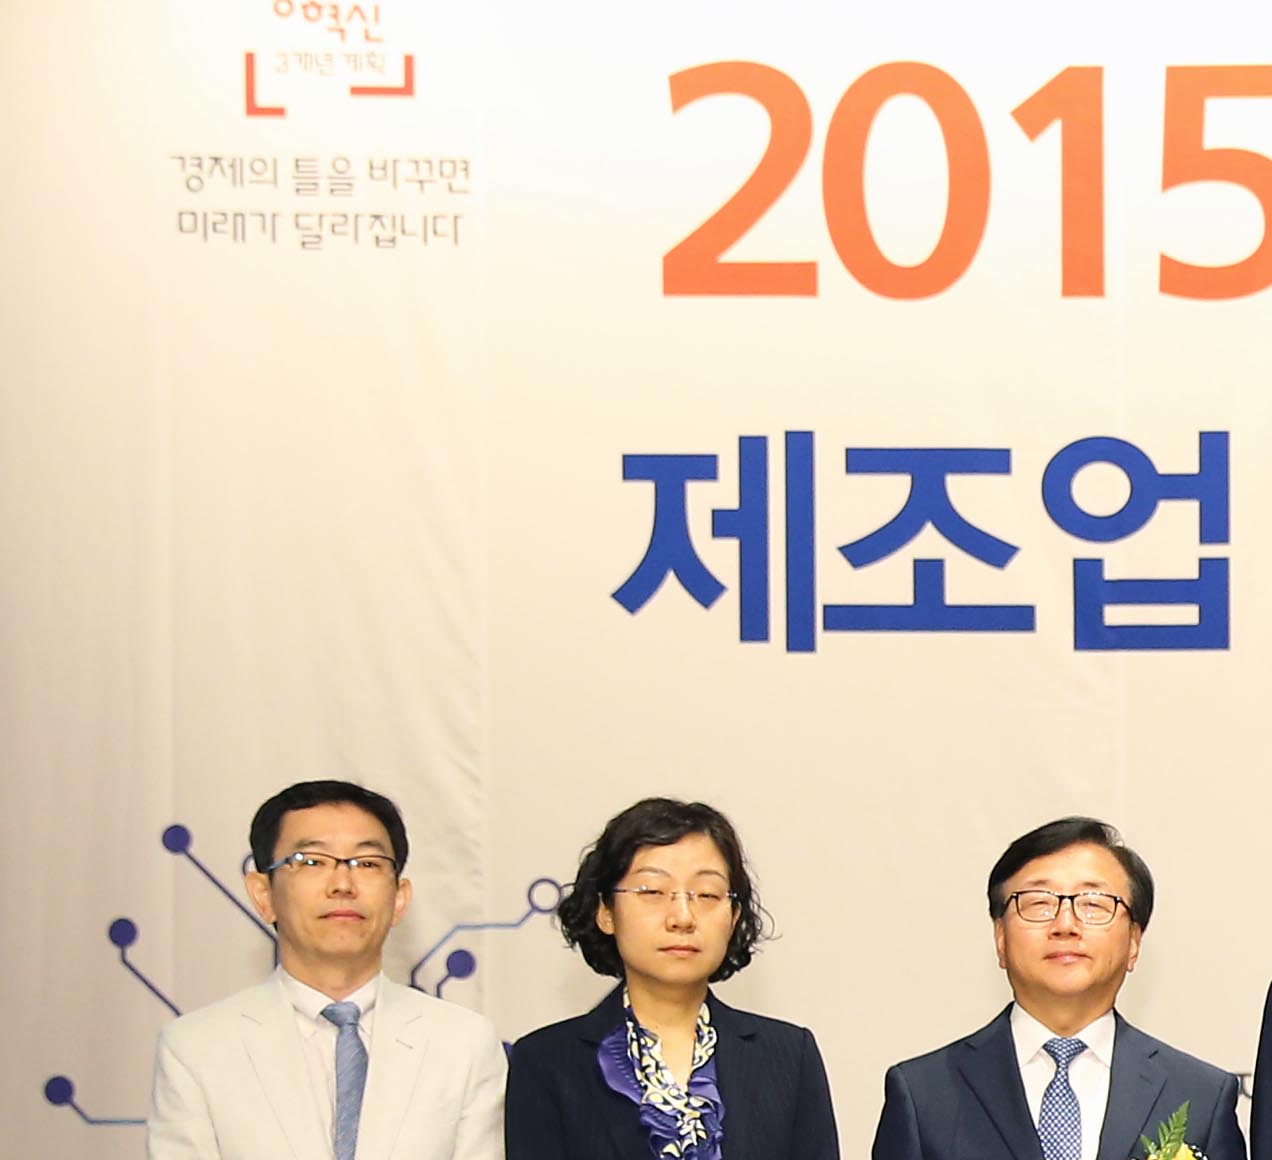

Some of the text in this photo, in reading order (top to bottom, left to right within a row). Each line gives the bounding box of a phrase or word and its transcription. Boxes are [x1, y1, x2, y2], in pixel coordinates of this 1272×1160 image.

[171, 156, 473, 197] 경제의 틀을 바꾸면
[177, 210, 464, 251] 미래가 달라집니다
[613, 430, 1231, 653] 제조업
